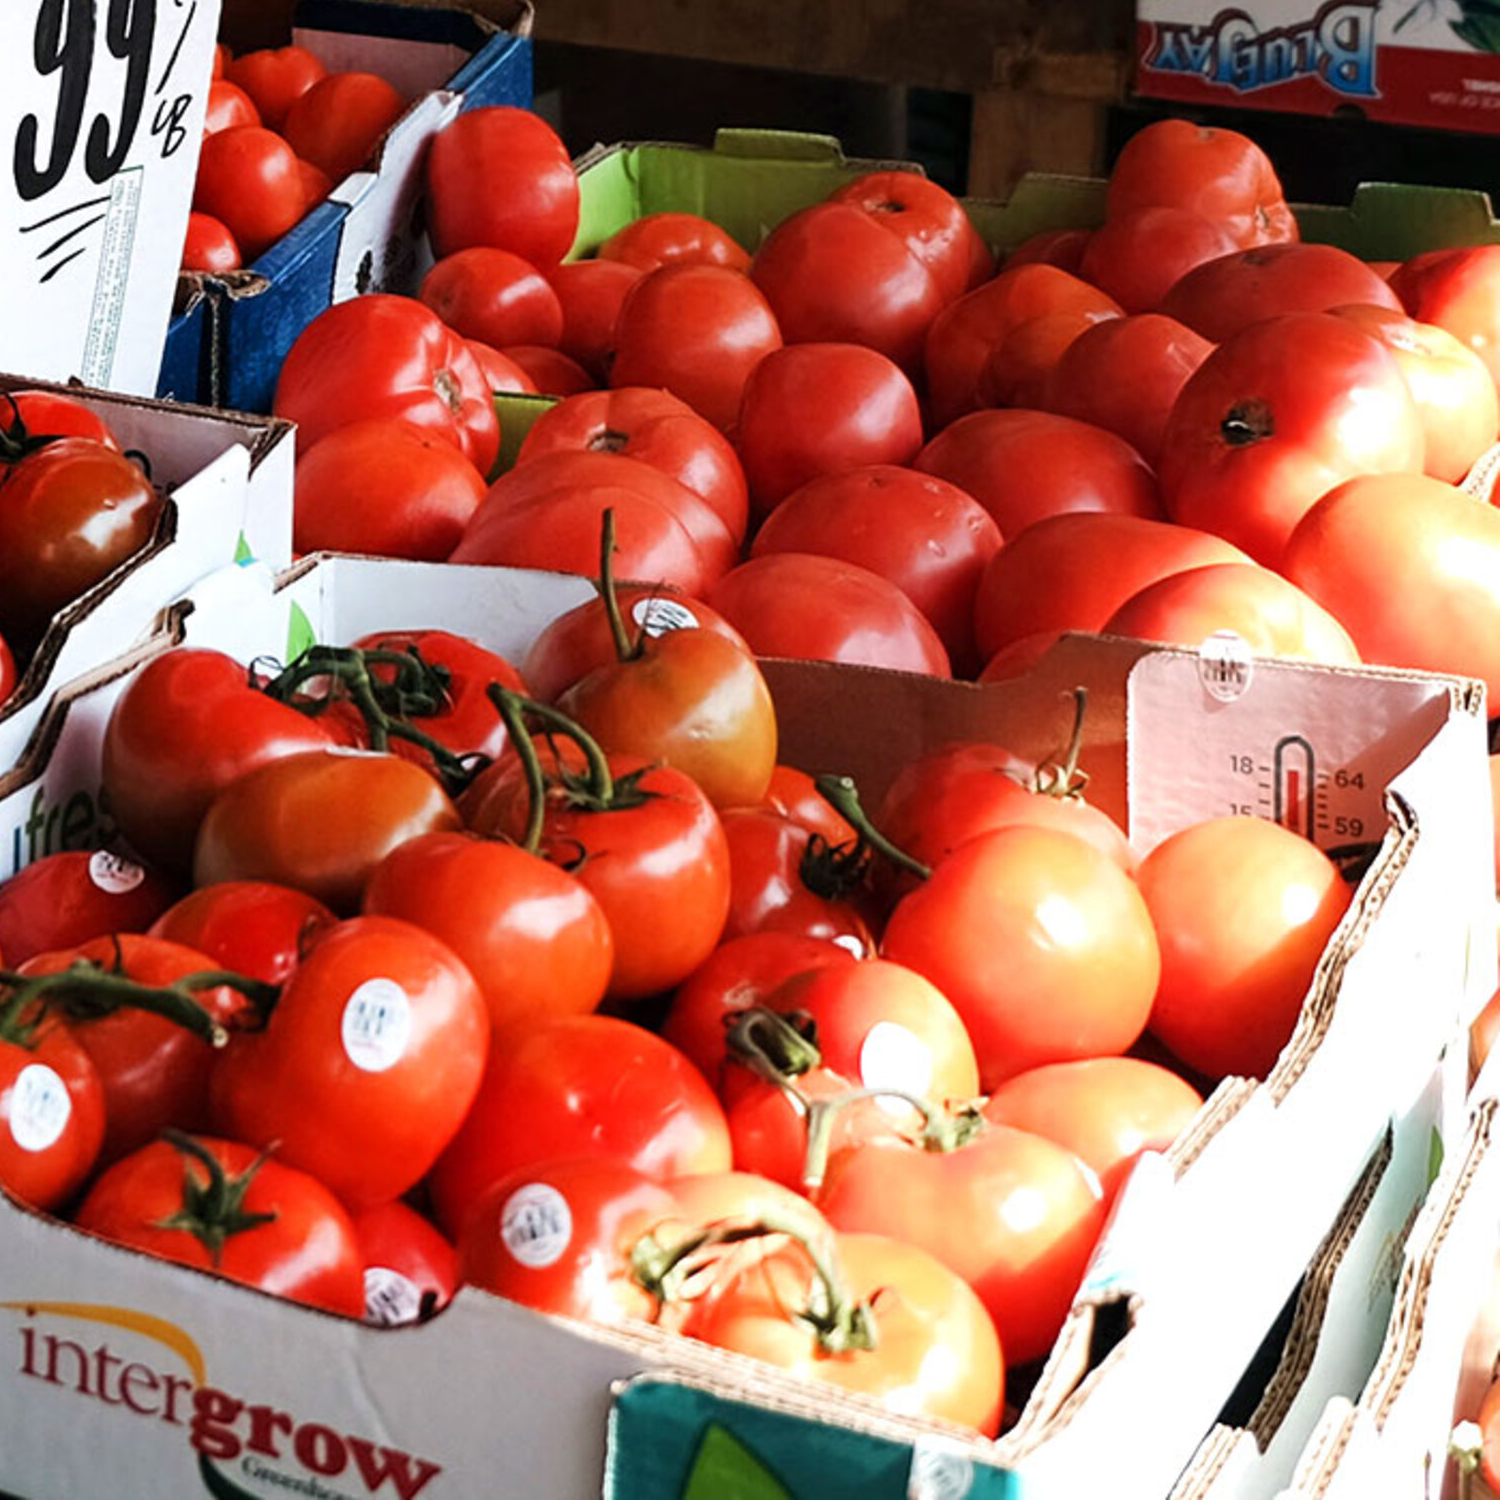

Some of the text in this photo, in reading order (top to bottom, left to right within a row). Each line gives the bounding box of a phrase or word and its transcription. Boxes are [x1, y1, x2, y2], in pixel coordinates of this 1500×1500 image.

[1229, 755, 1365, 791] 18 64
[1334, 817, 1364, 837] 59
[19, 1306, 442, 1500] intergrow
